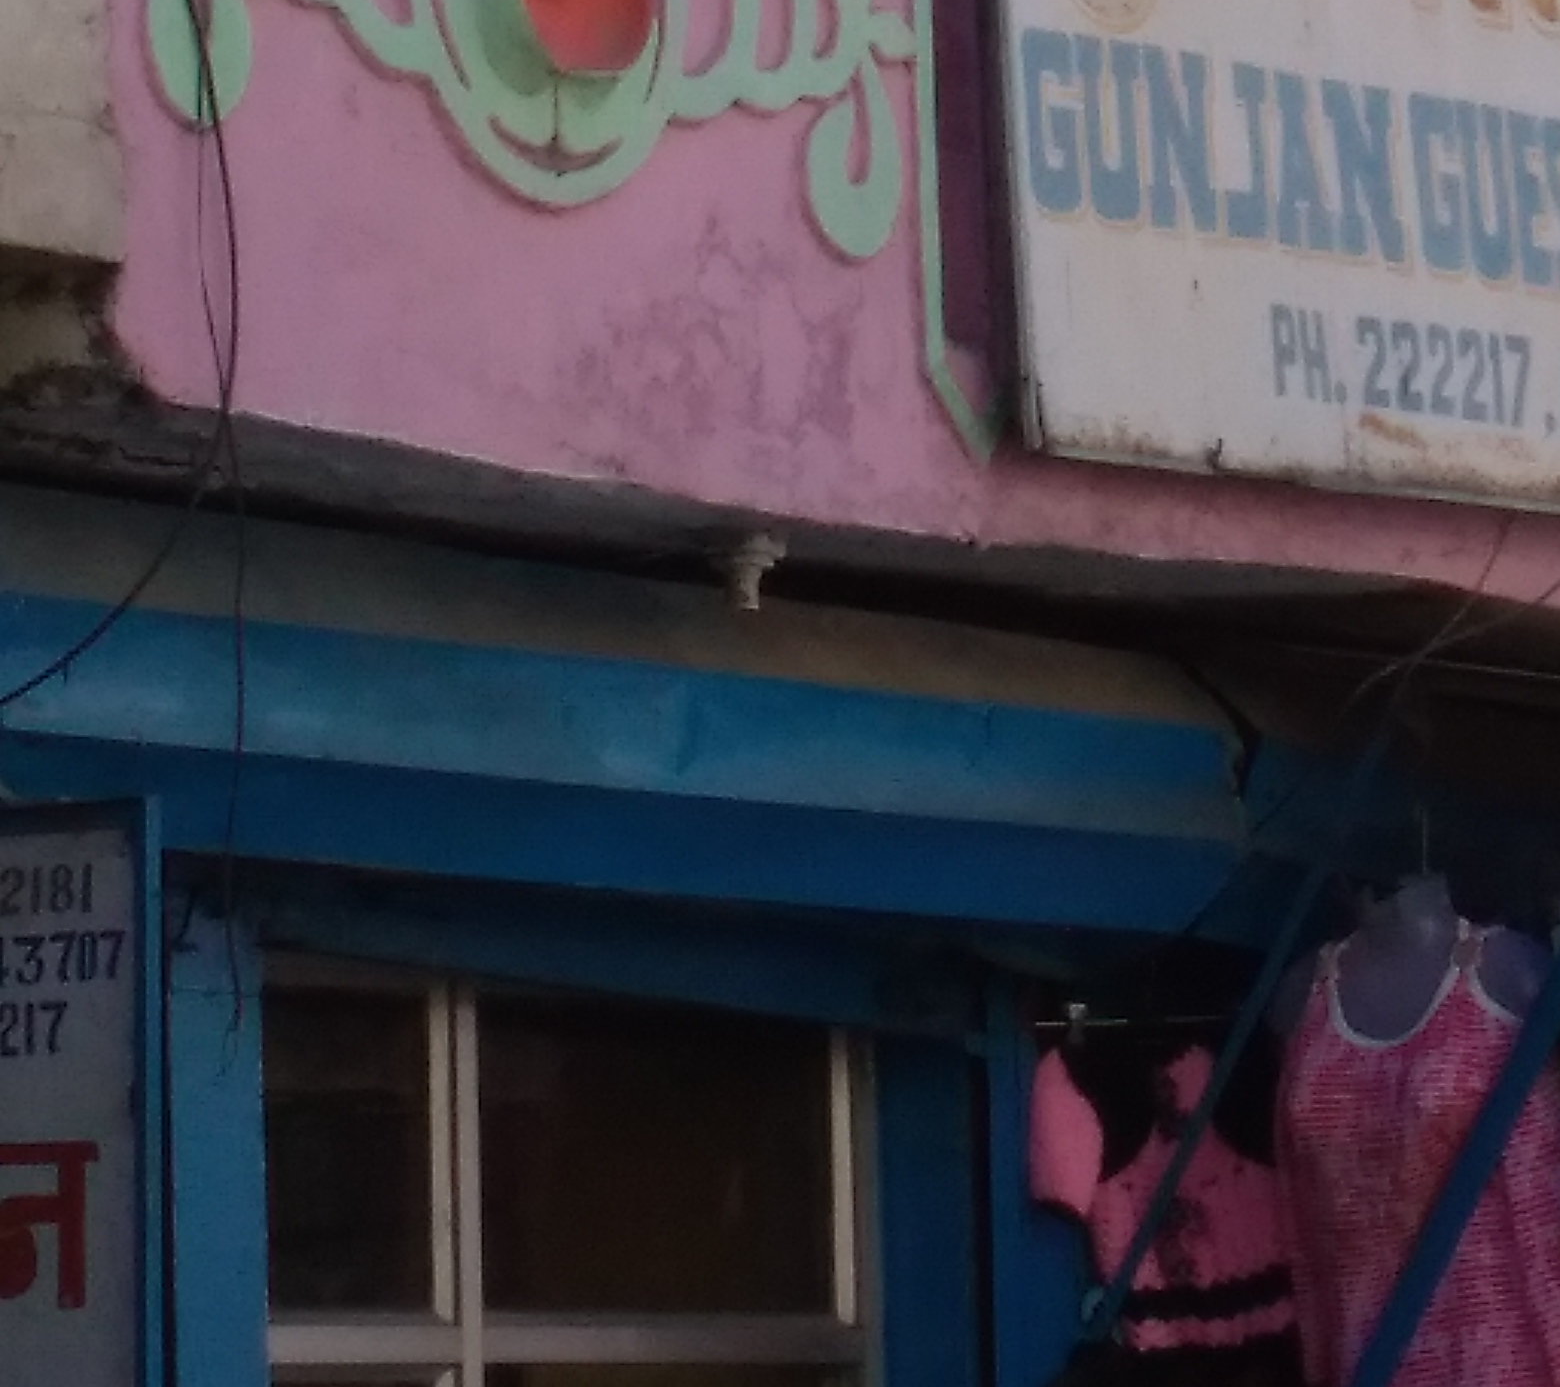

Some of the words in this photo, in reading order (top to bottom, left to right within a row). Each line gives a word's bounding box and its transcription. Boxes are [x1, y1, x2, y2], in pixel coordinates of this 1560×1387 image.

[1019, 26, 1412, 271] GUNJAN
[1269, 302, 1349, 406] PH.
[0, 929, 126, 987] 3707
